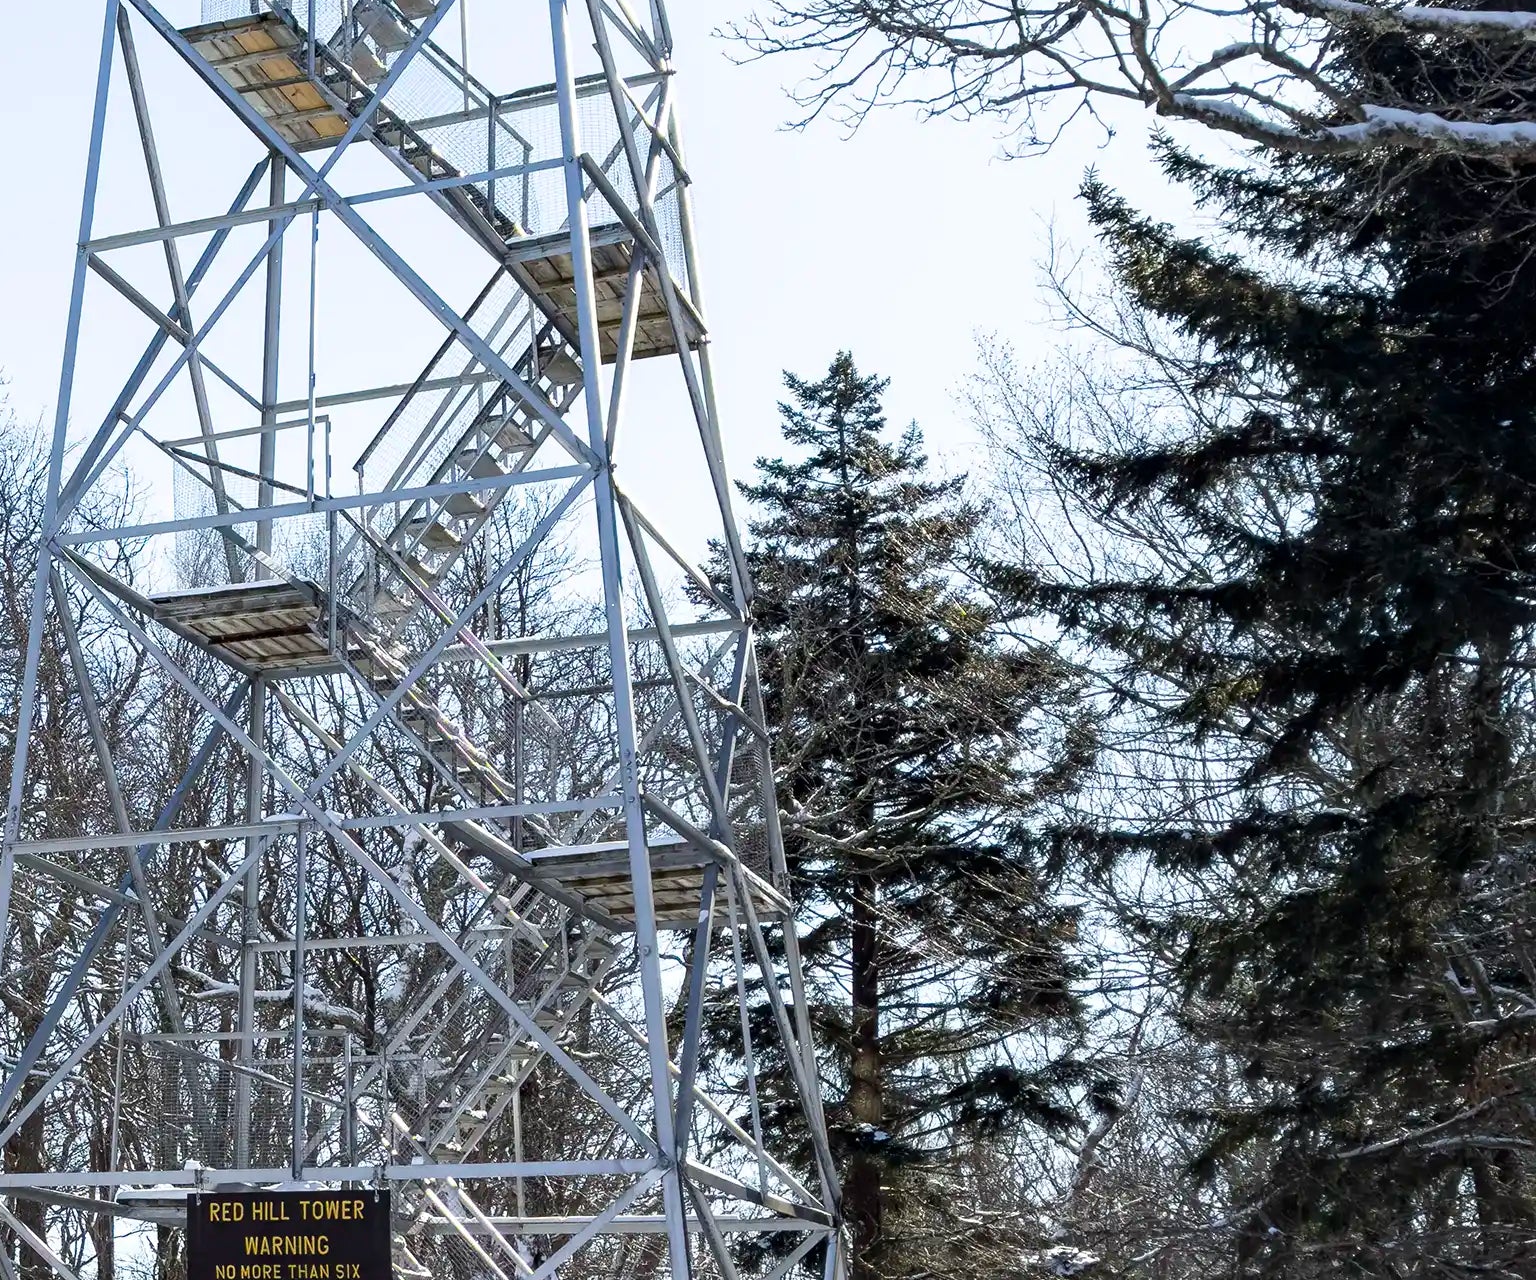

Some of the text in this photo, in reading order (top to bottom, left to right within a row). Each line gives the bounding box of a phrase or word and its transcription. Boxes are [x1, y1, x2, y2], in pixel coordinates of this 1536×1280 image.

[209, 1200, 365, 1222] RED HILL TOWER
[244, 1235, 330, 1256] WARNING
[215, 1263, 361, 1280] NO MORE THAN SIX
